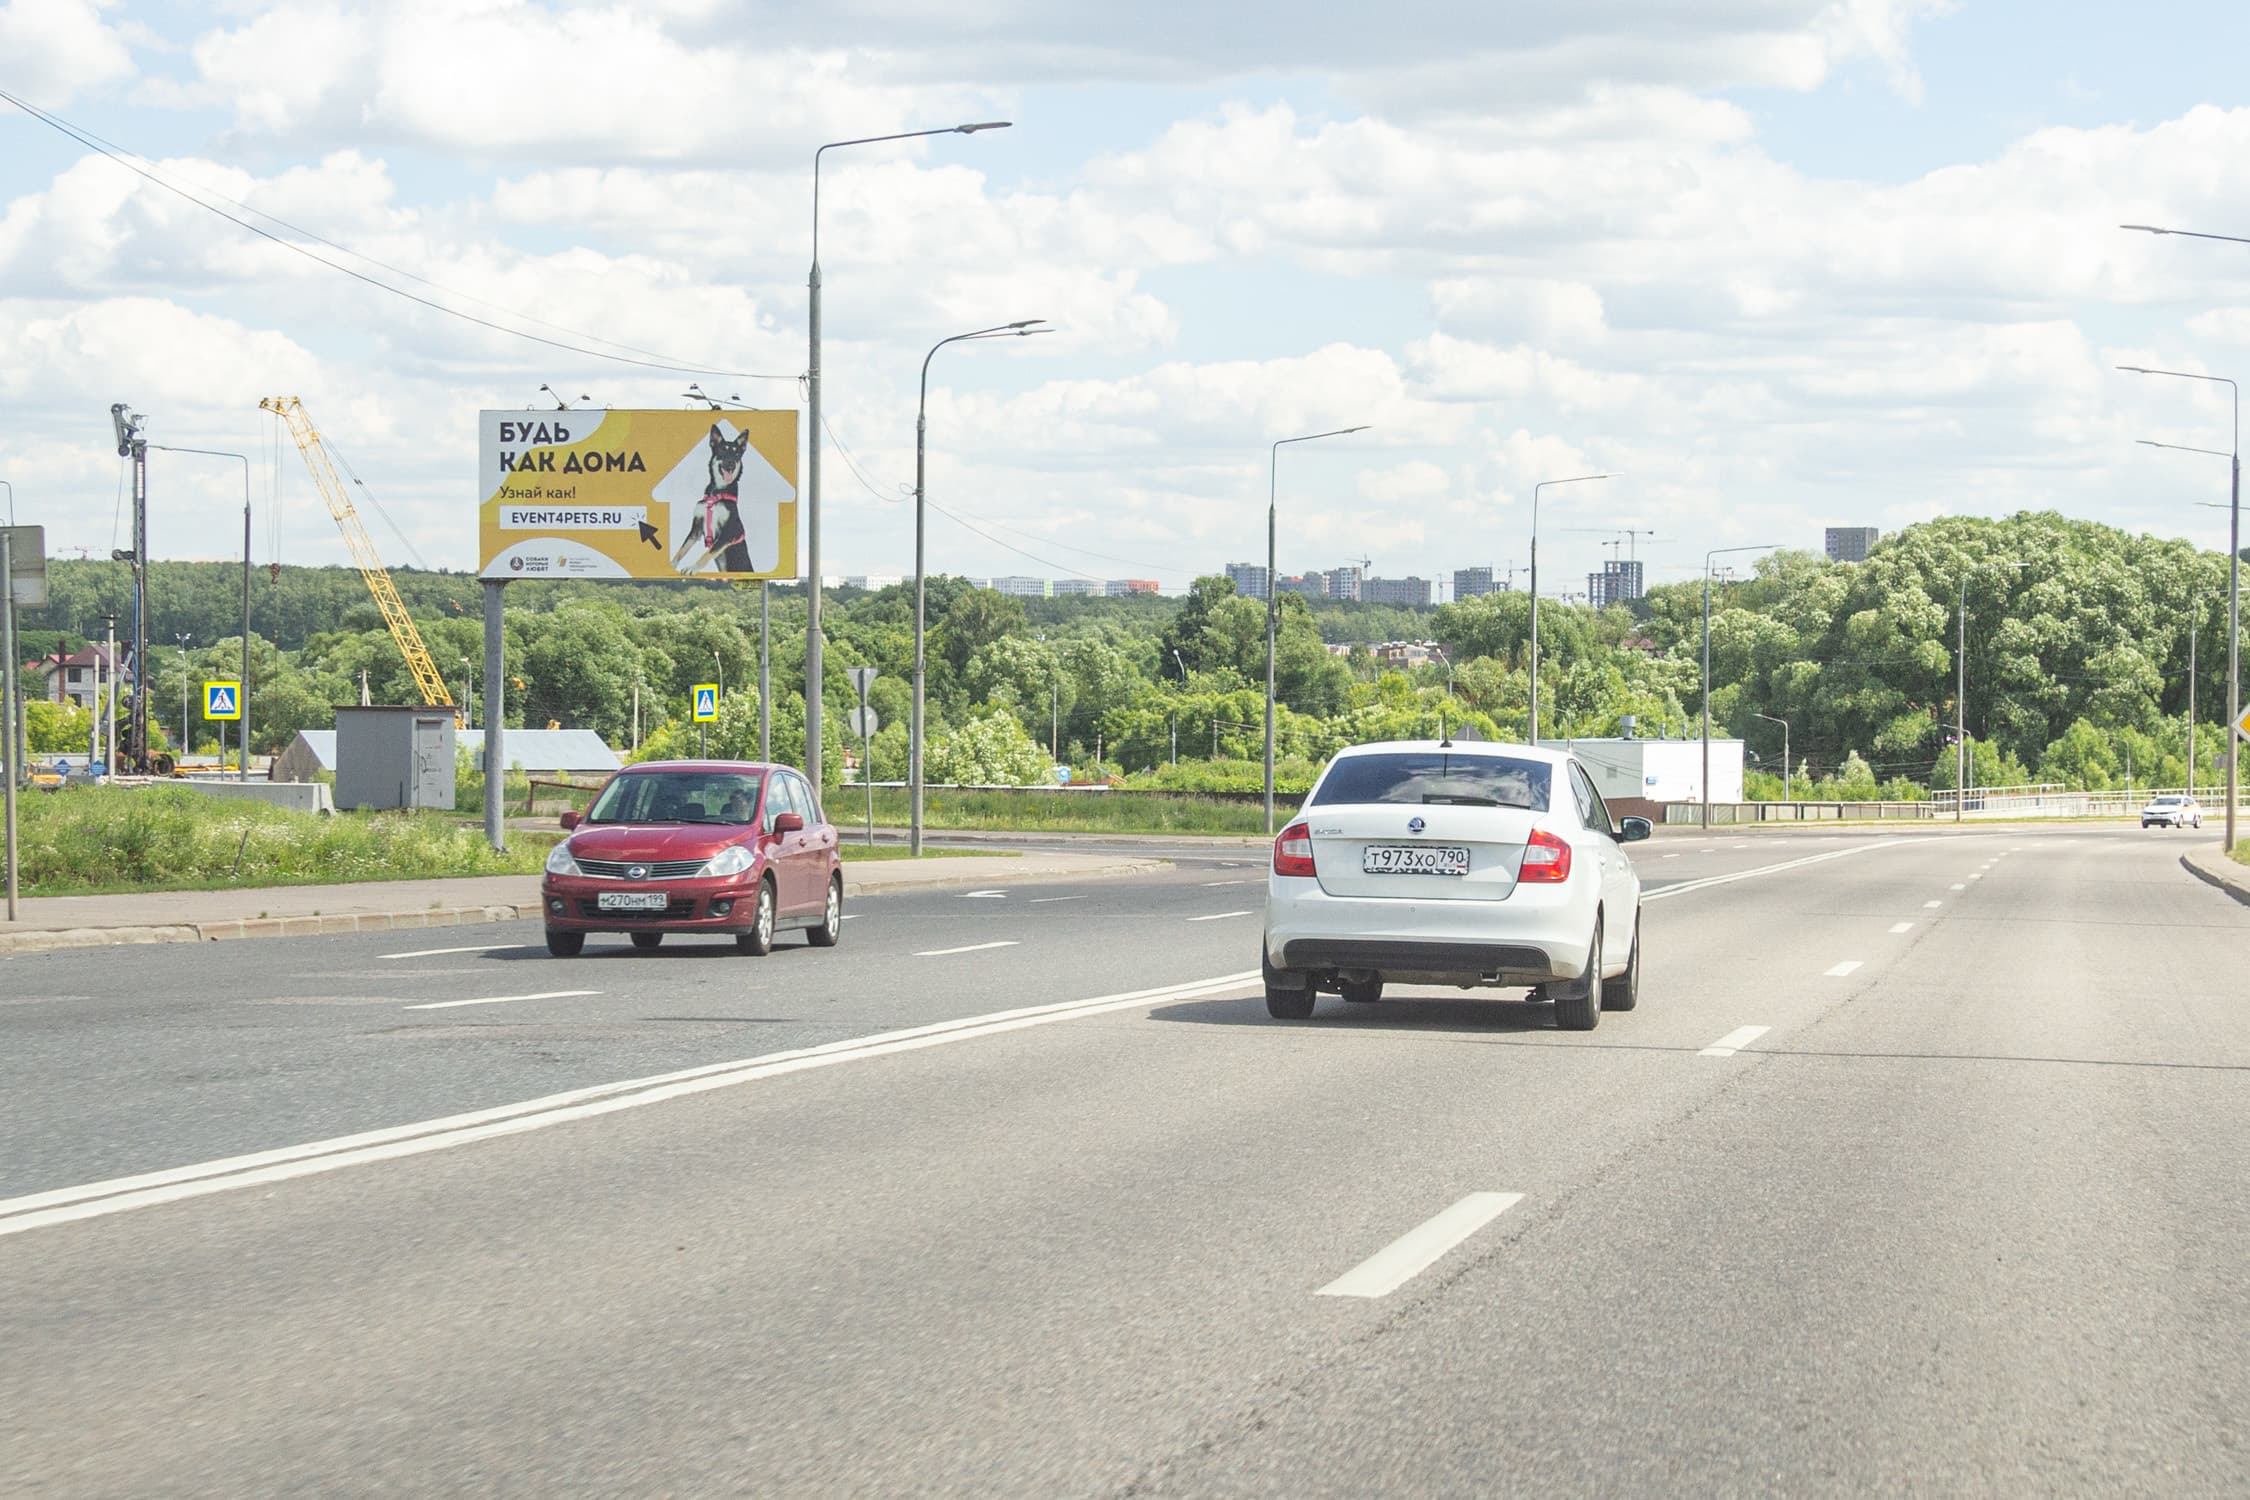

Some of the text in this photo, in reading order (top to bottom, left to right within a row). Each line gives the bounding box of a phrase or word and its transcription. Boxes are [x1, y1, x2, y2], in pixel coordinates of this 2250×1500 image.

[500, 422, 570, 445] БУДЬ
[500, 451, 647, 474] КАК ДОМА
[500, 486, 576, 499] Узнай как!
[511, 512, 622, 524] EVENT4PETS.RU
[1371, 850, 1464, 867] Т973ХО 790
